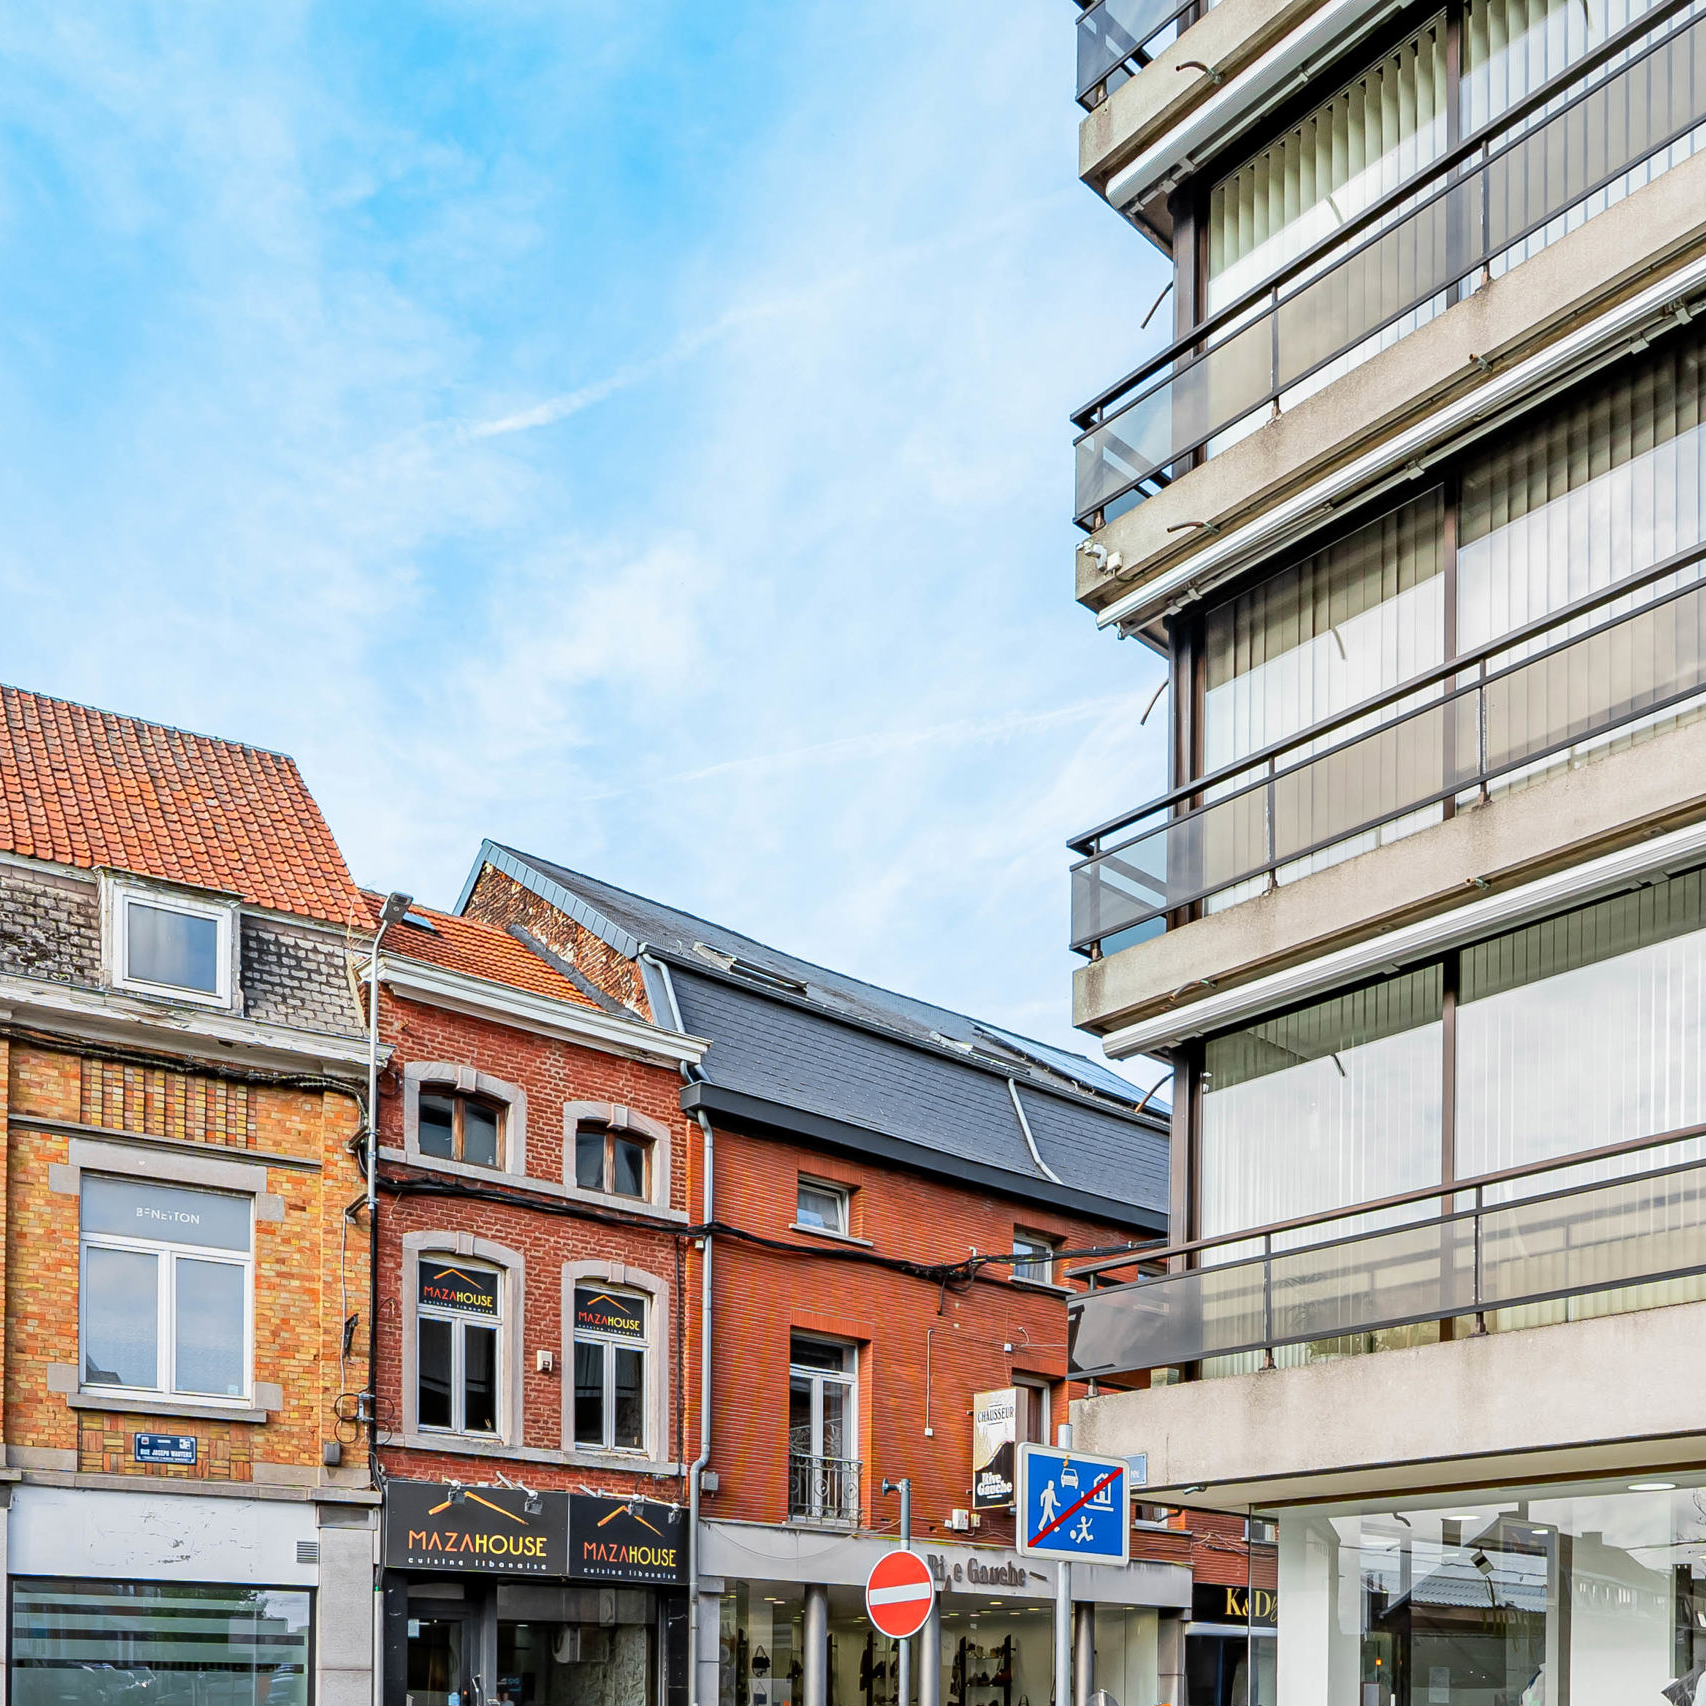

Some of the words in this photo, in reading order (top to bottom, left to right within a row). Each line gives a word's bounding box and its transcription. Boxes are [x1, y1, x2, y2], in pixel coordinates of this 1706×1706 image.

[423, 1286, 493, 1307] MAZAHOUSE
[578, 1311, 640, 1331] MAZAHOUSE
[978, 1406, 1014, 1423] CHAUSSEUR
[977, 1481, 1013, 1496] Gauche
[408, 1530, 547, 1557] MAZAHOUSE
[408, 1557, 464, 1566] cuisine
[475, 1560, 547, 1570] libanaise
[583, 1542, 677, 1567] MAZAHOUSE
[967, 1558, 1026, 1588] Gauche
